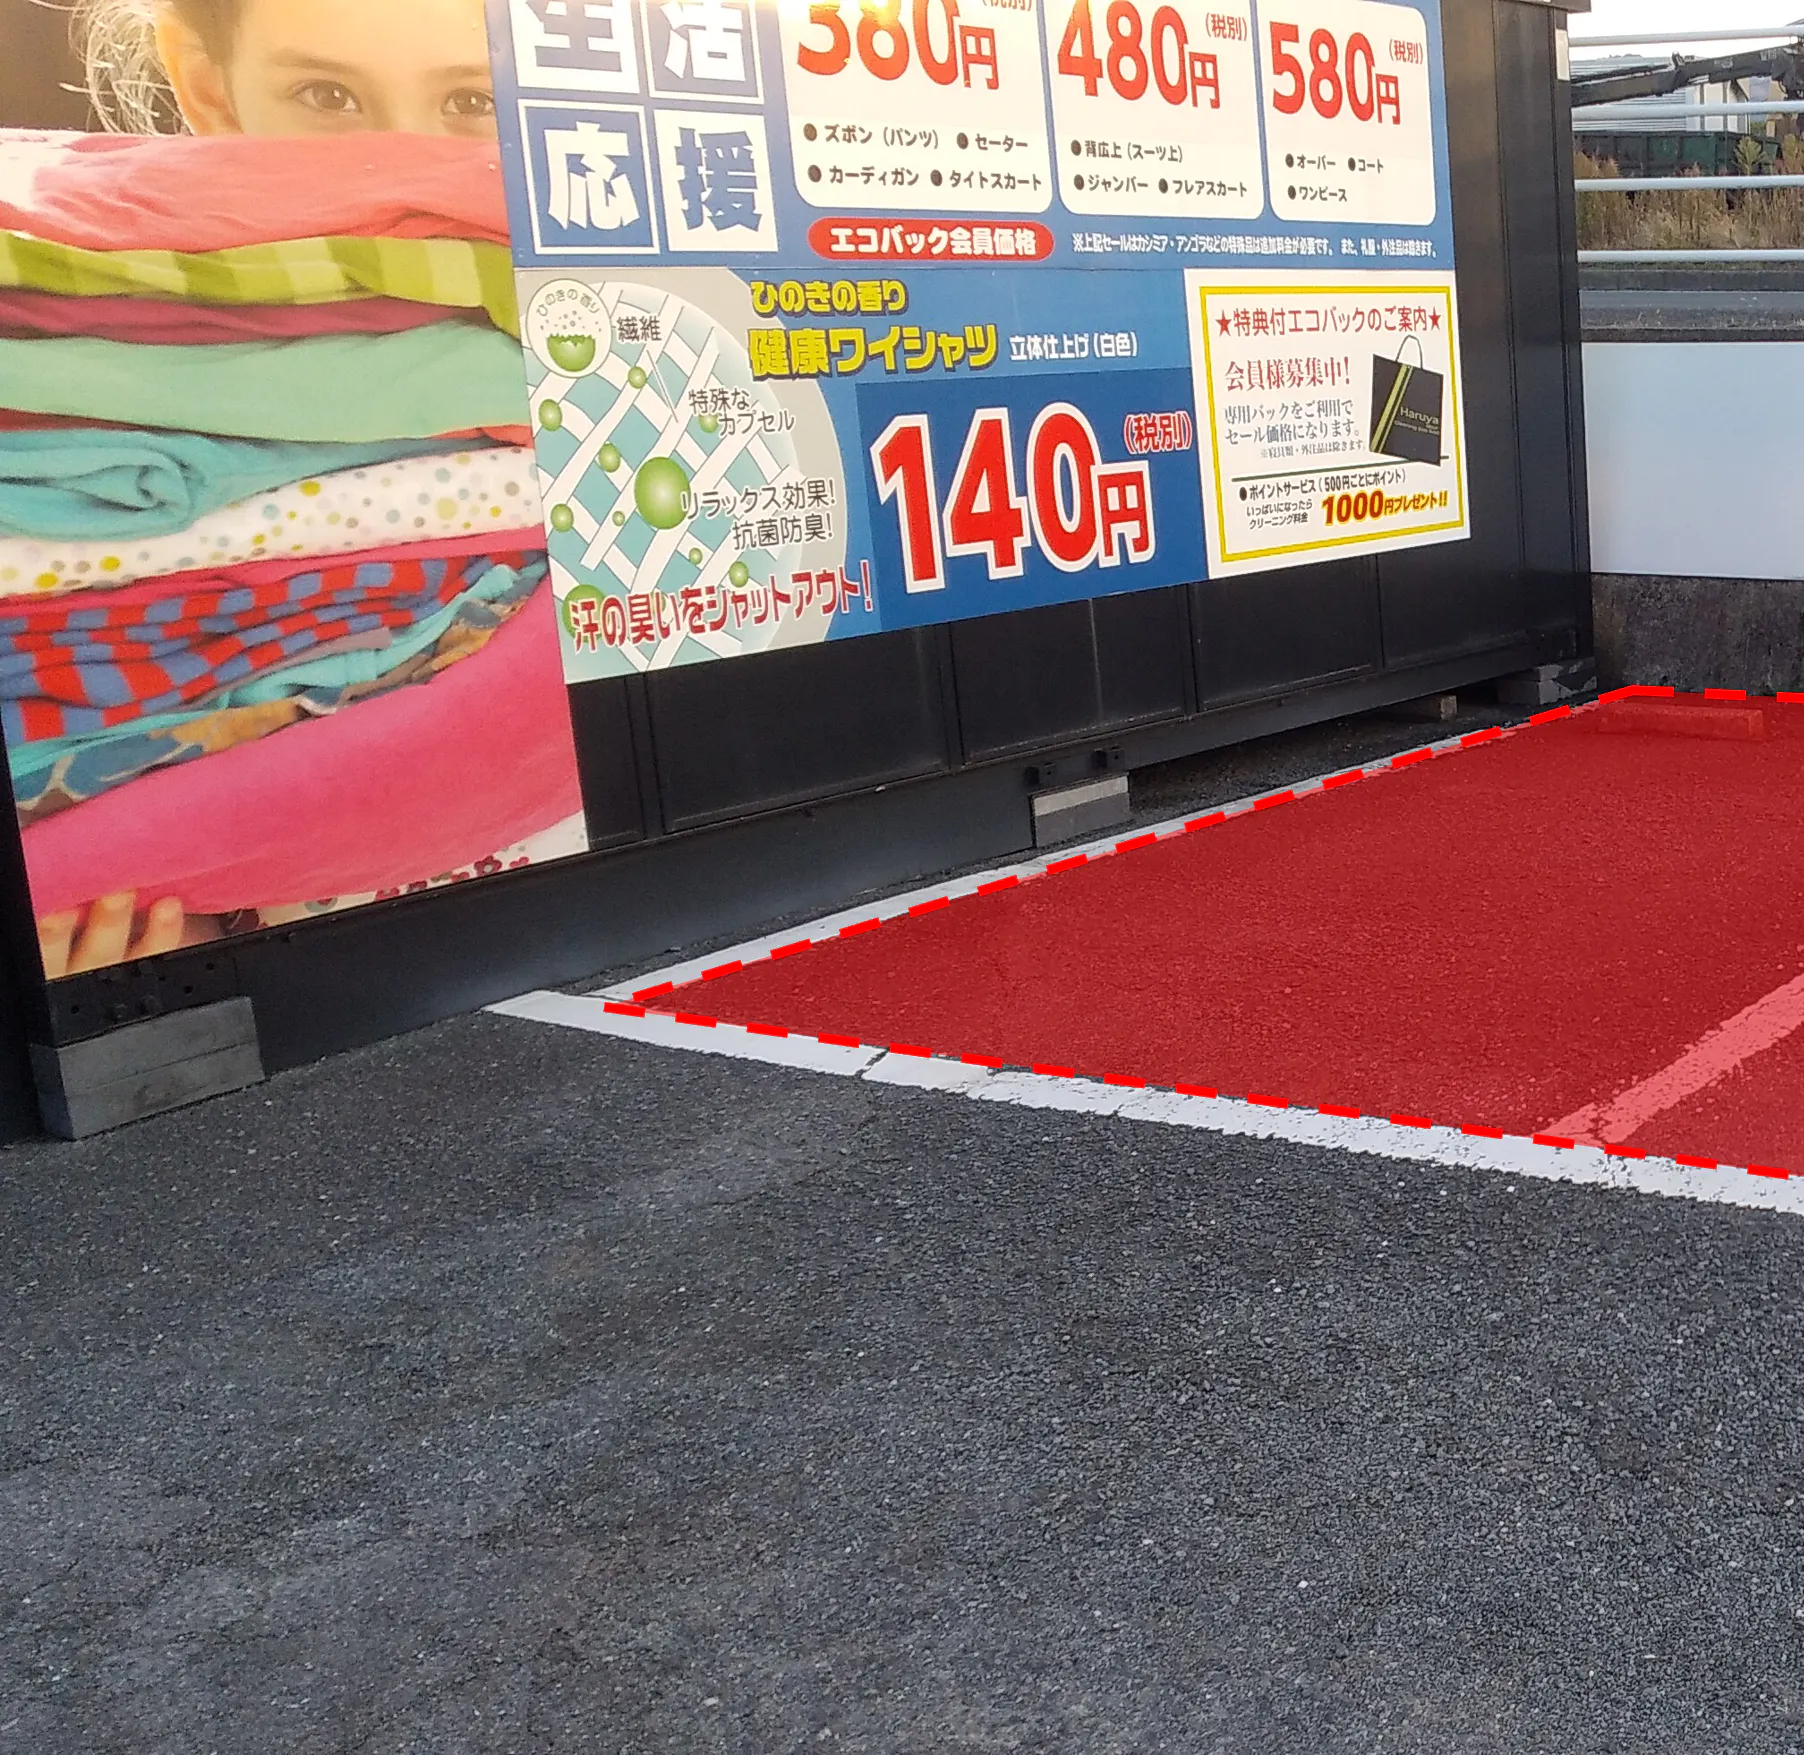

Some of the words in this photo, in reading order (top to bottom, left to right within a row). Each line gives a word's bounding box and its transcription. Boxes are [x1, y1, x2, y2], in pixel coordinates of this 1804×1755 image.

[526, 0, 747, 81] 生活
[1205, 12, 1248, 42] (税別)
[1057, 0, 1222, 110] 480円
[1388, 38, 1424, 65] (税別)
[1269, 20, 1401, 126] 580円
[975, 134, 1028, 153] セーター
[829, 165, 919, 188] カーディガン
[1296, 154, 1337, 171] オーバー
[1358, 157, 1385, 174] コート
[546, 122, 762, 233] 応援
[949, 170, 1042, 192] タイトスカート
[1173, 180, 1247, 198] フレアスカート
[1298, 186, 1348, 203] ワンピース
[830, 225, 1037, 257] エコバック会員価格
[752, 281, 906, 313] ひのきの香り
[616, 315, 663, 343] 繊維
[750, 325, 998, 375] 健康ワイシャツ
[688, 387, 750, 415] 特殊な
[718, 410, 796, 438] カプセル
[1400, 406, 1440, 425] Haruya
[1124, 410, 1193, 454] (税別)
[872, 402, 1153, 588] 140円
